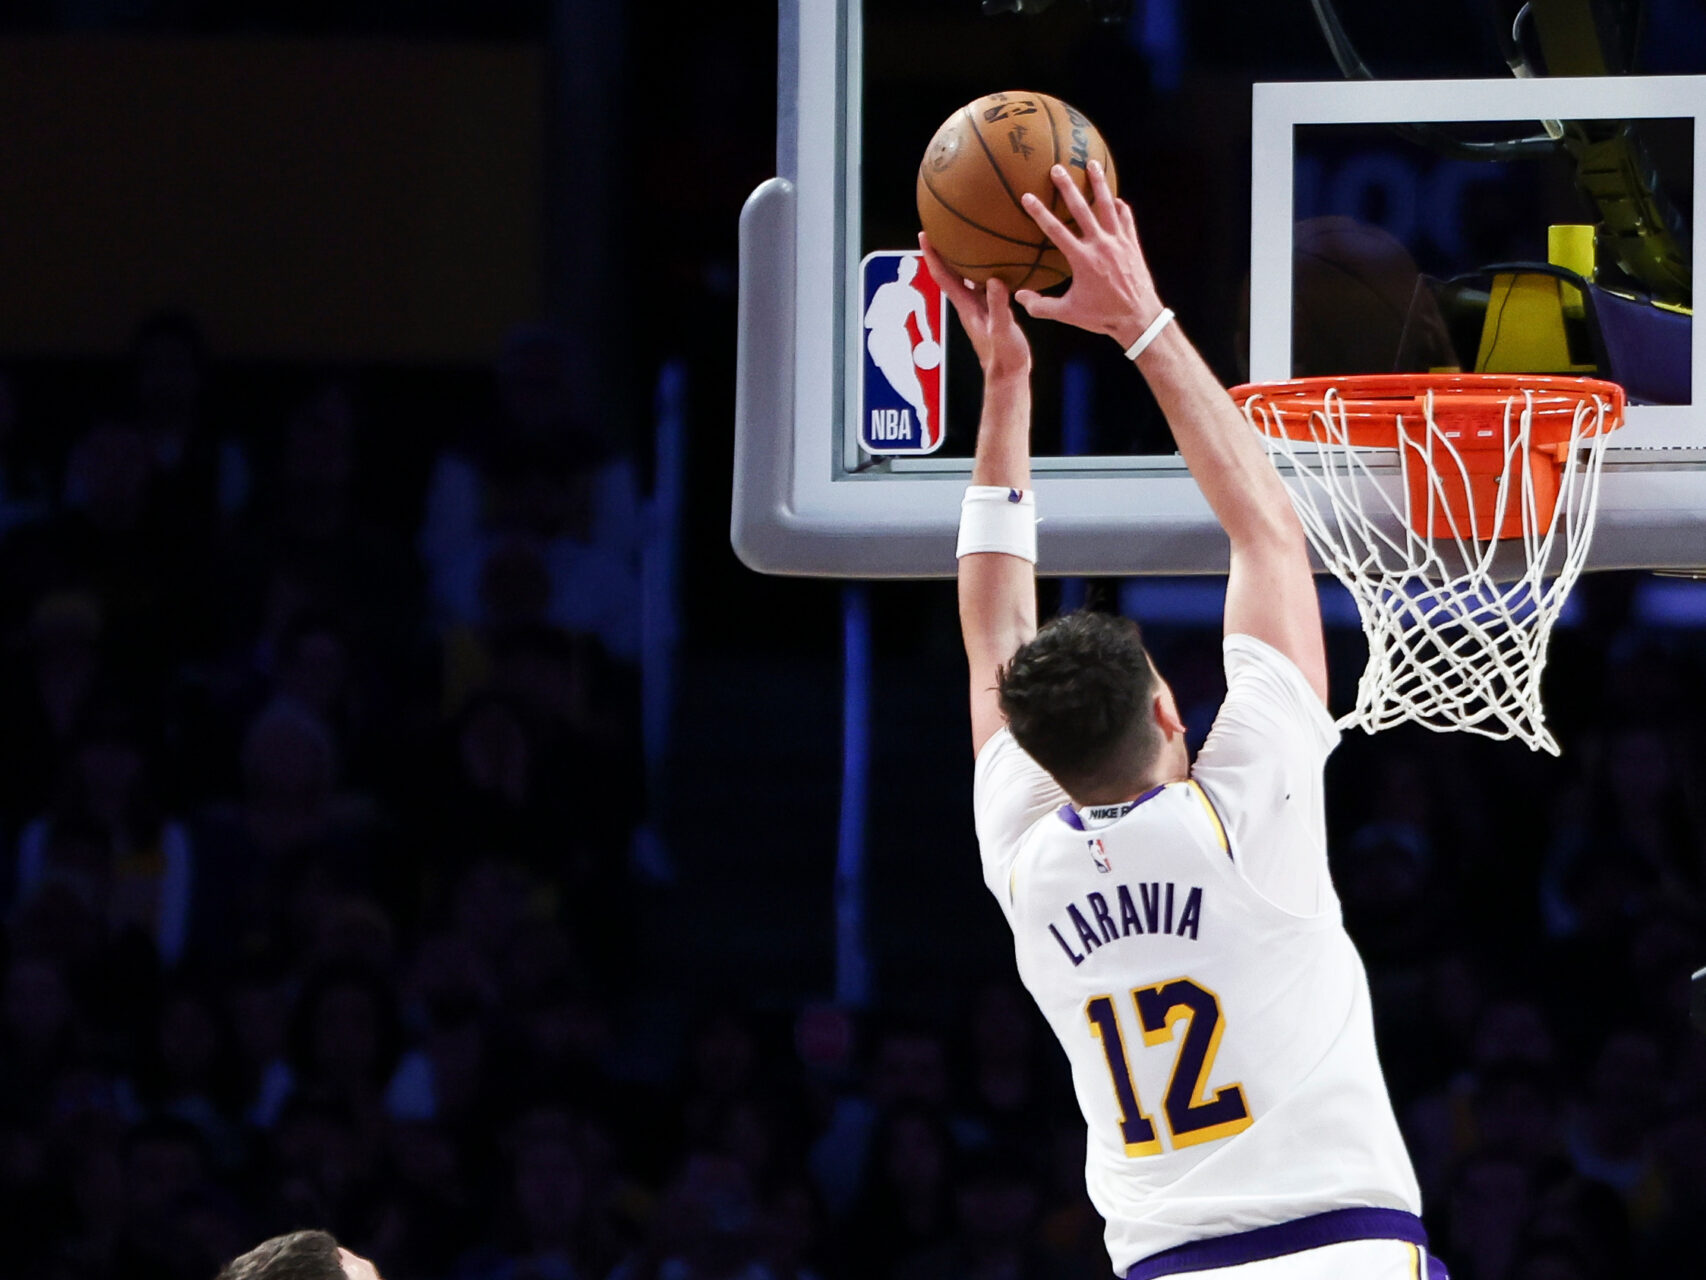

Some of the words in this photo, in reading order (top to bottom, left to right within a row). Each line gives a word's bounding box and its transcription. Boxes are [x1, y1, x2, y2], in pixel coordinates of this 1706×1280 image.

[871, 409, 911, 440] NBA
[1089, 807, 1118, 819] NIKE
[1048, 882, 1203, 967] LARAVIA
[1084, 975, 1254, 1158] 12
